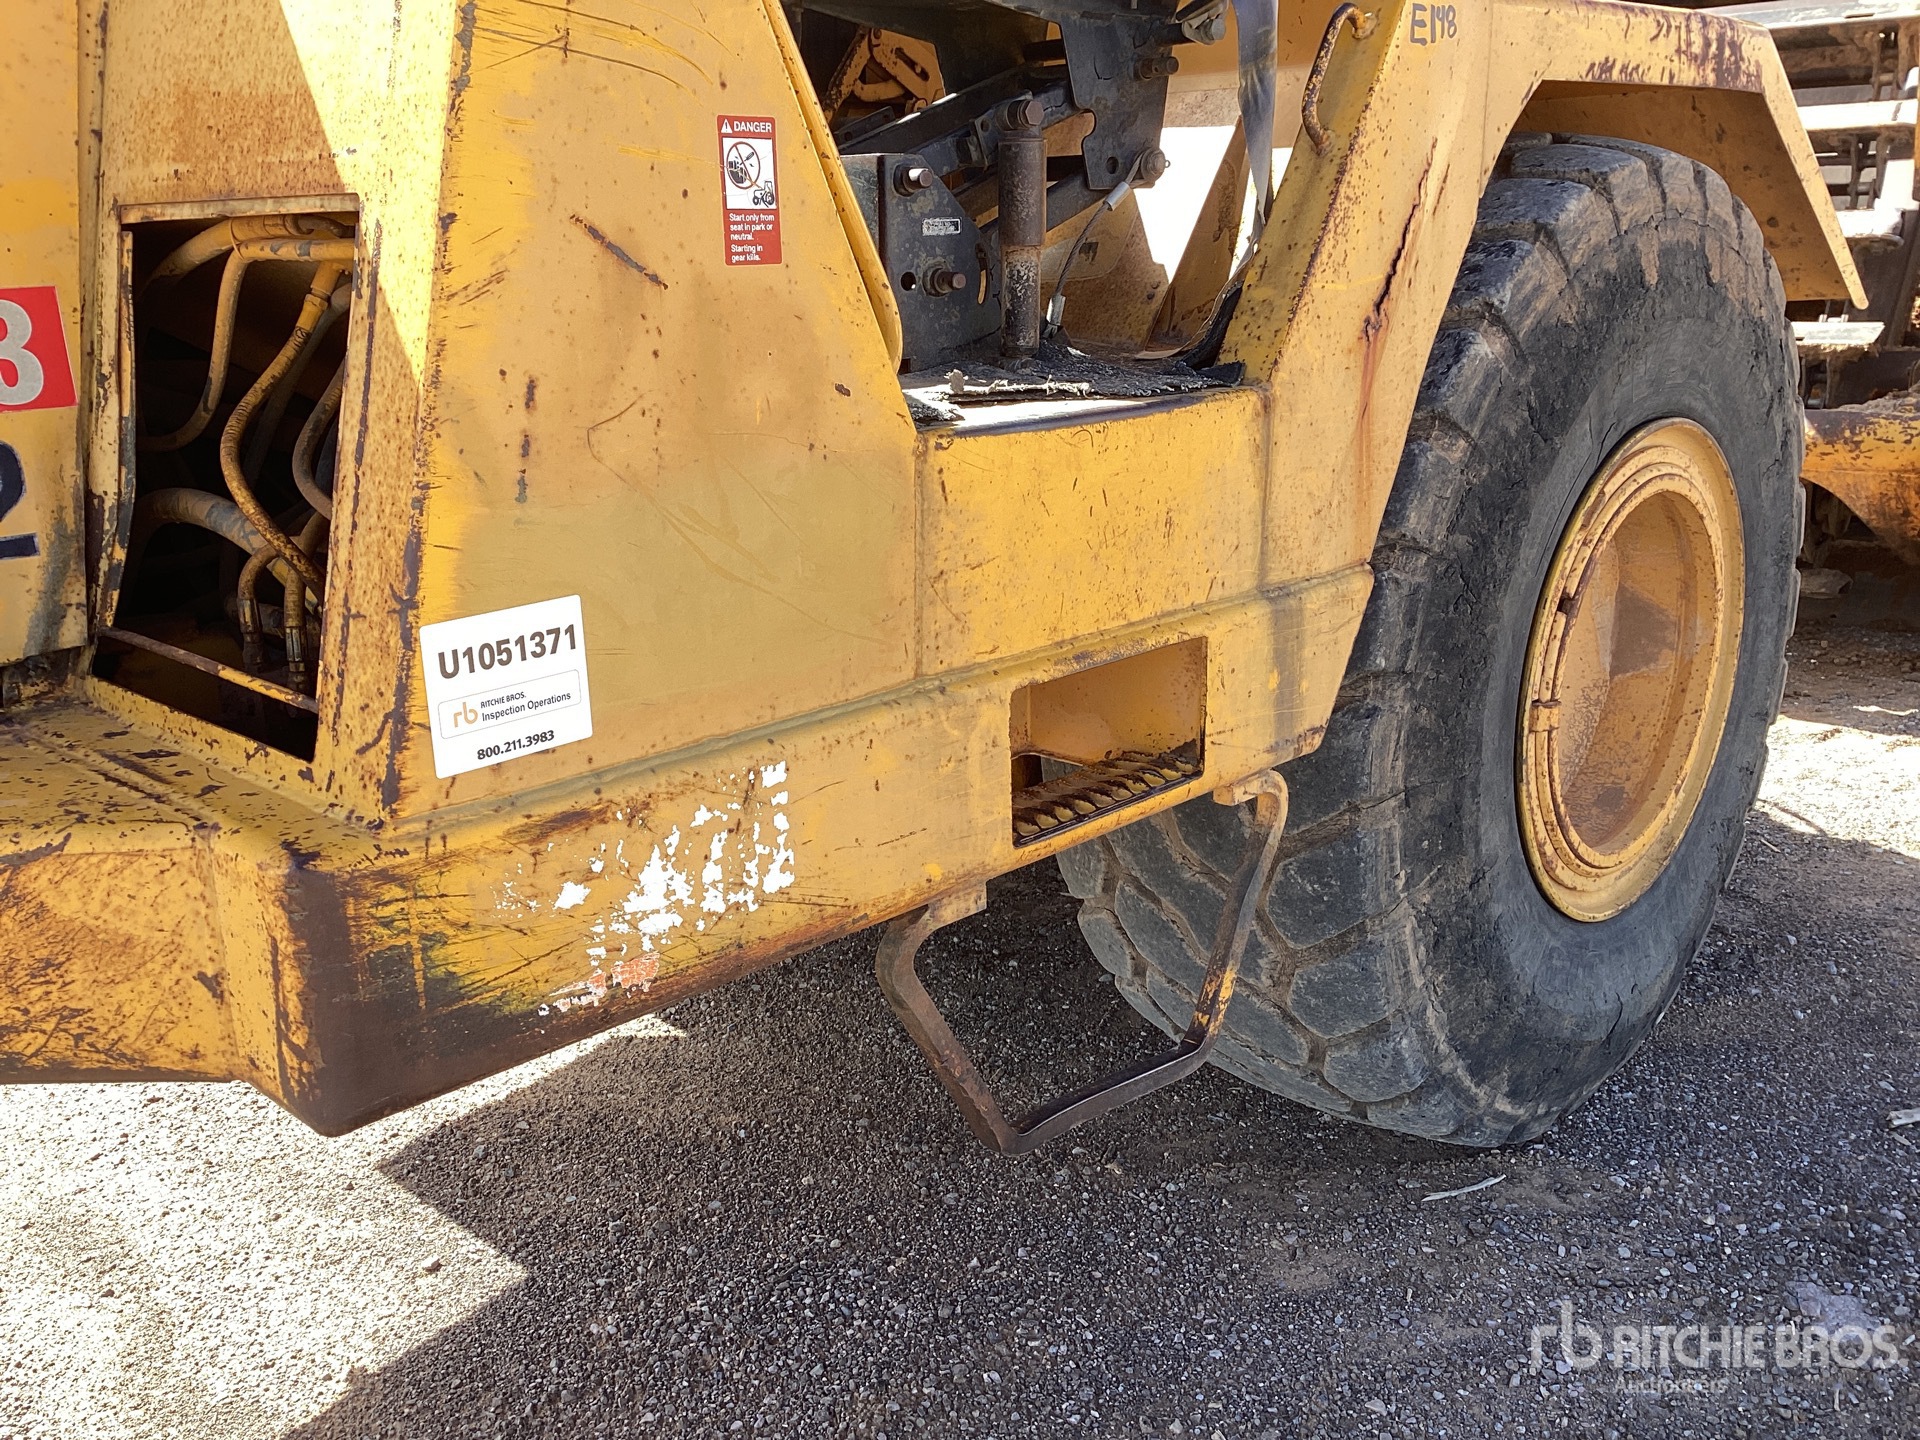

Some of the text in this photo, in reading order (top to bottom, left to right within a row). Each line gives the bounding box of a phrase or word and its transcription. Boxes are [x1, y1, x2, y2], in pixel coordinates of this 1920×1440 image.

[1410, 3, 1457, 46] E148
[733, 120, 772, 133] DANGER
[729, 213, 775, 223] Start only from
[730, 223, 744, 231] seat
[744, 223, 751, 231] in
[751, 223, 766, 232] park
[730, 232, 754, 241] neutral.
[731, 244, 756, 253] Starting
[731, 253, 761, 263] gear kills.
[437, 624, 576, 680] U1051371
[480, 691, 527, 709] RITCHIE BROS.
[481, 692, 572, 722] Inspection Operations
[477, 729, 555, 760] 800.211.3983
